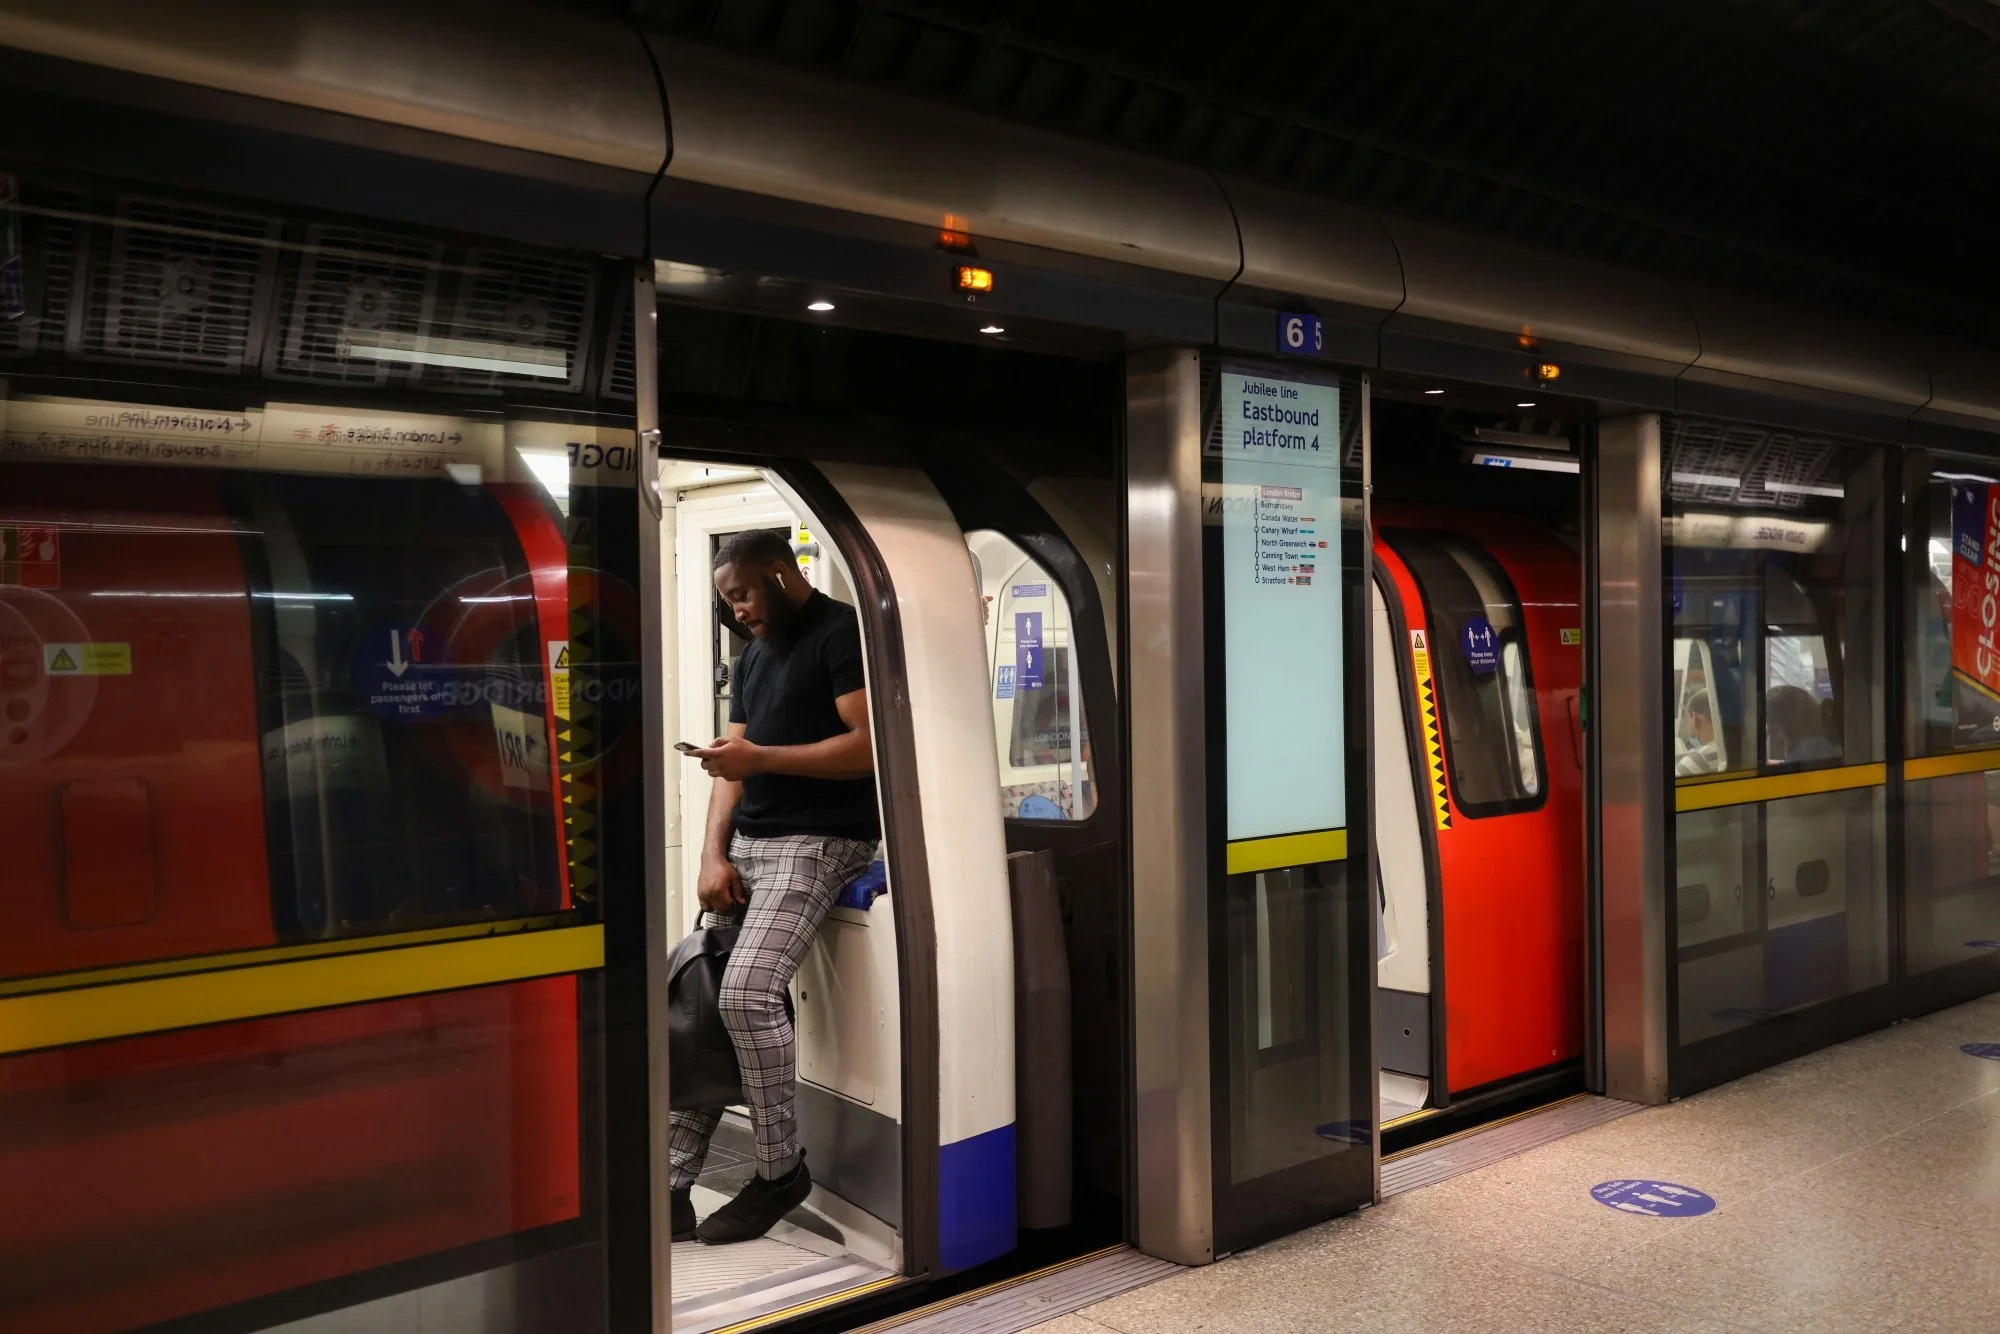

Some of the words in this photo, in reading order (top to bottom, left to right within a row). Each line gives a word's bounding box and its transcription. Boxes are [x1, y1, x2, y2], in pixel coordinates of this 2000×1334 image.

[1286, 318, 1304, 348] 6
[1315, 321, 1322, 350] 5
[1242, 381, 1278, 397] Jubilee
[1280, 385, 1298, 400] line
[1243, 400, 1319, 427] Eastbound
[1243, 427, 1306, 450] platform
[1311, 435, 1320, 450] 4
[1261, 514, 1281, 522] Canada
[1281, 514, 1298, 522] Water
[1261, 526, 1280, 535] Canary
[1281, 527, 1298, 535] Wharf
[1961, 532, 1980, 552] STAND
[1261, 551, 1283, 560] Canning
[1284, 552, 1299, 560] Town
[1261, 564, 1276, 572] West
[1261, 576, 1286, 584] Stratford
[382, 681, 417, 691] Please
[418, 681, 433, 690] let
[371, 692, 429, 705] passengers
[399, 704, 421, 713] first
